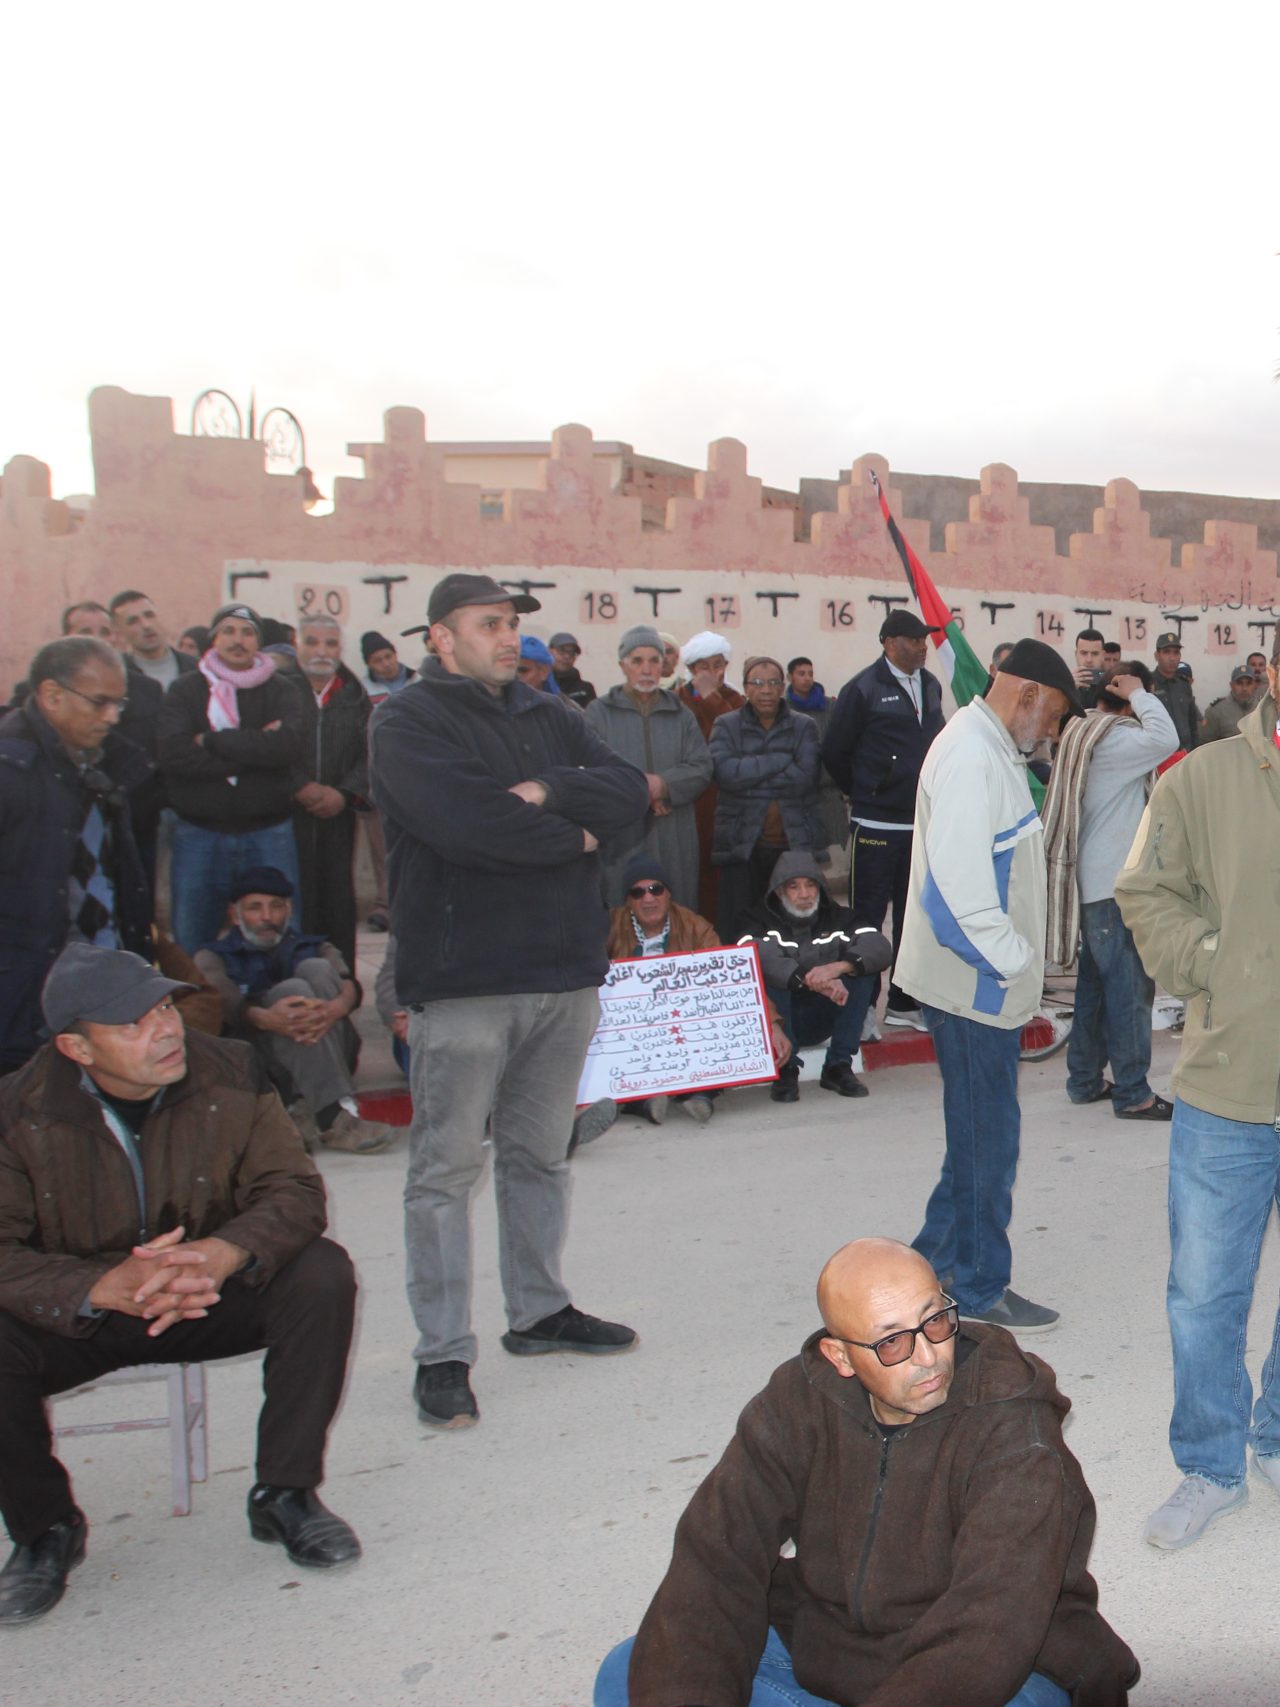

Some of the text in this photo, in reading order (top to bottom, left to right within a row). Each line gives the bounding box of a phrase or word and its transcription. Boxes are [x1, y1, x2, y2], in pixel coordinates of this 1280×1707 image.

[298, 588, 342, 616] 20
[584, 592, 617, 619] 18
[705, 596, 737, 623] 17
[827, 601, 853, 627] 16
[1037, 611, 1065, 637] 14
[1125, 617, 1147, 641] 13
[1214, 624, 1236, 647] 12
[637, 961, 676, 984] الشعوب
[691, 956, 724, 978] تقرير
[726, 956, 748, 970] حق
[693, 970, 729, 987] ذهب
[731, 969, 751, 983] من
